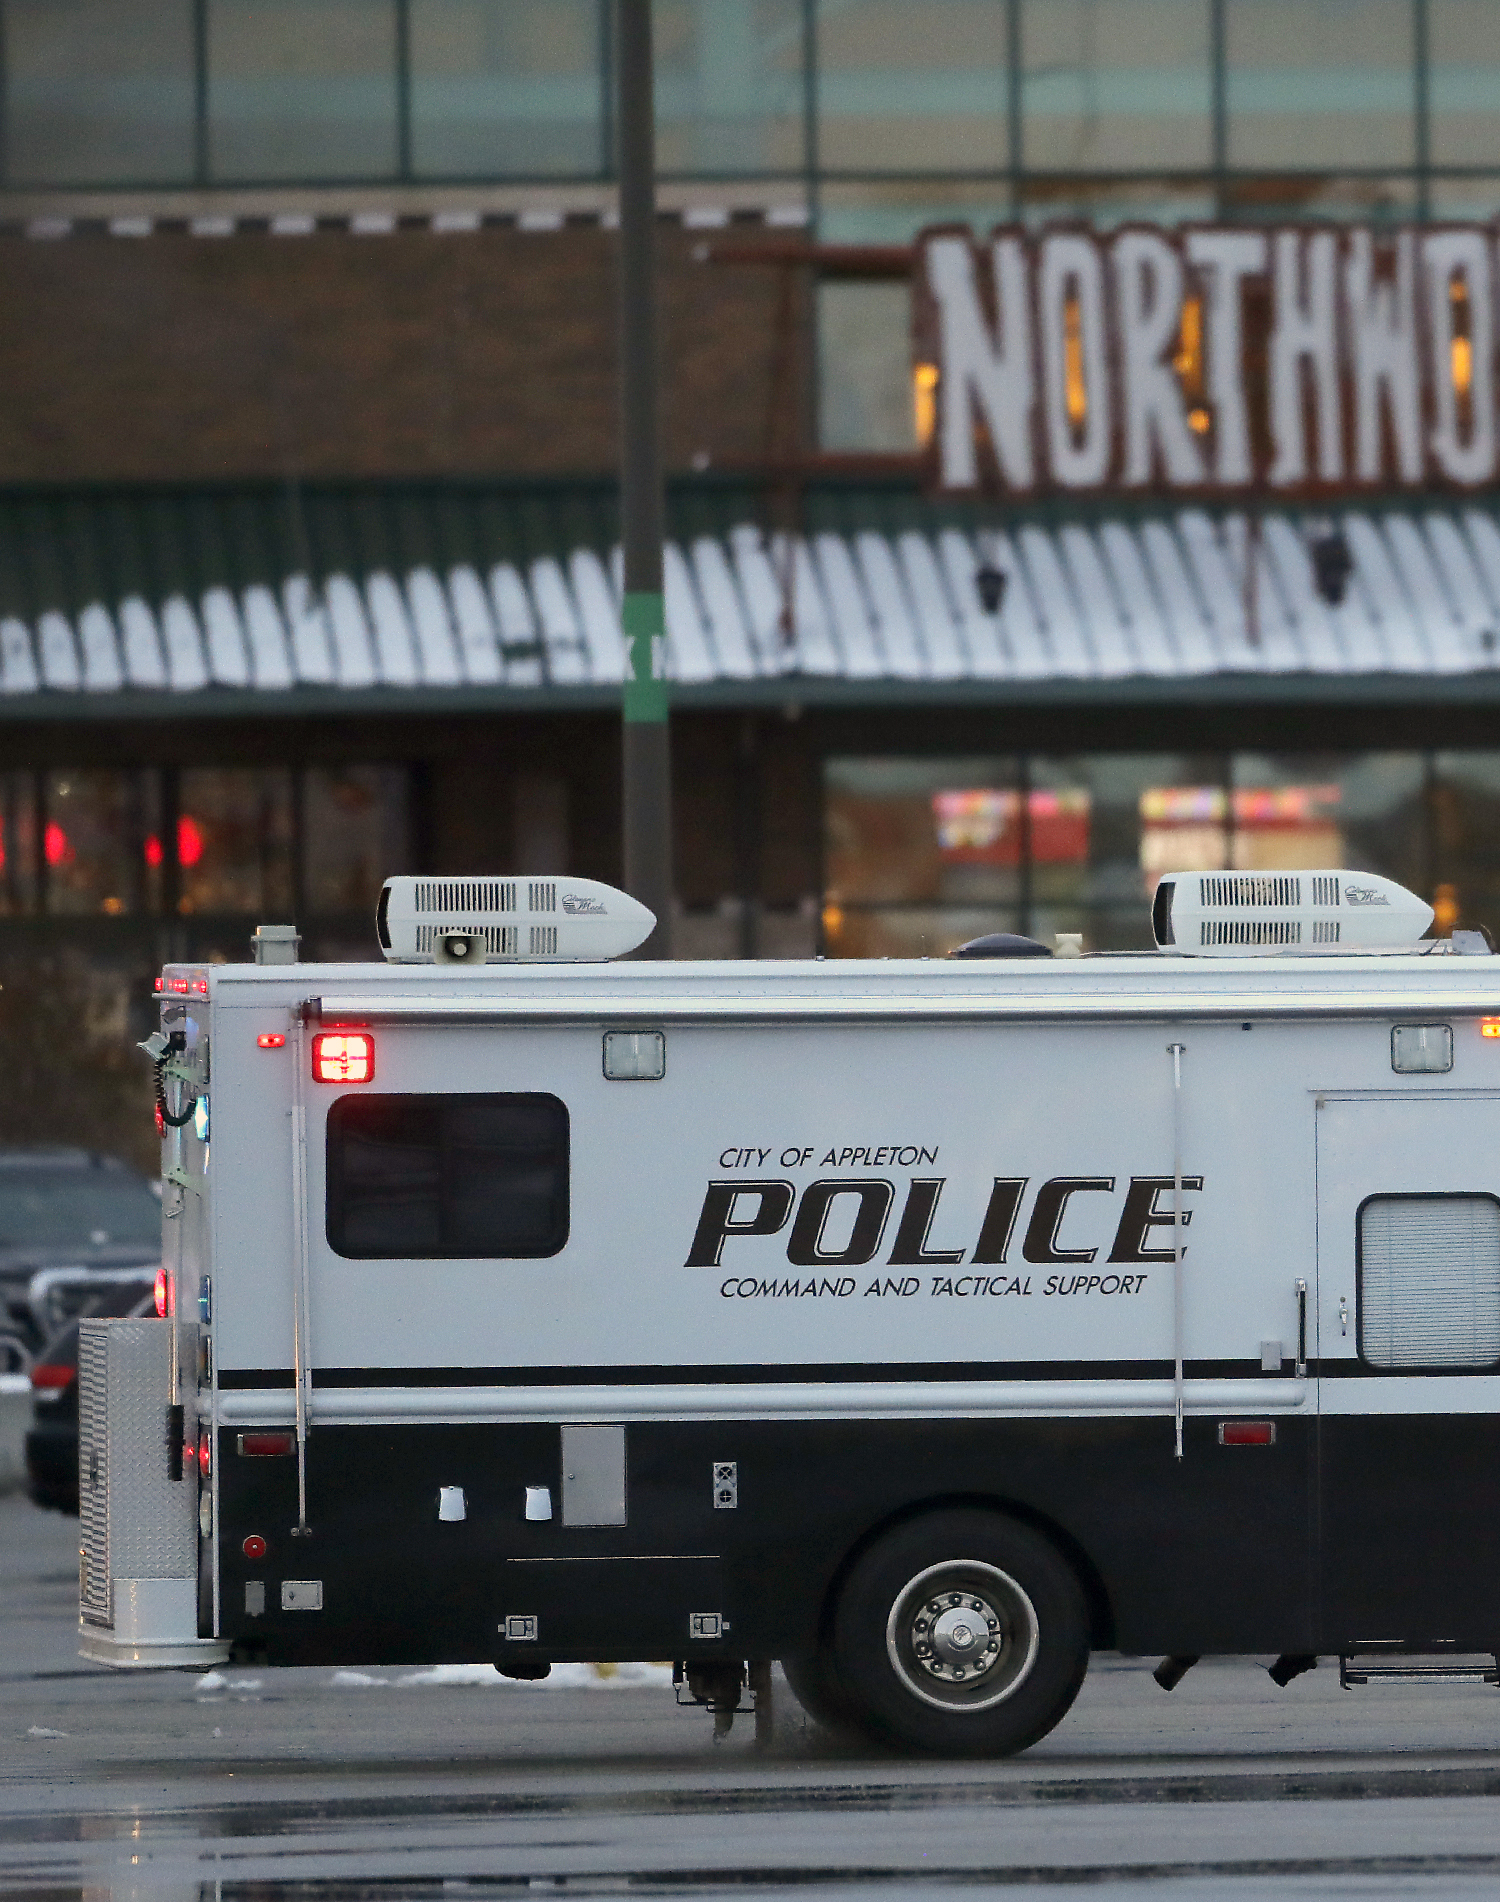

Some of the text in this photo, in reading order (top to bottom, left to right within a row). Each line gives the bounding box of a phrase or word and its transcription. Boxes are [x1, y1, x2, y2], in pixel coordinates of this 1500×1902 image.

[719, 1145, 939, 1169] CITY OF APPLETON
[683, 1176, 1204, 1268] POLICE
[720, 1274, 1148, 1299] COMMAND AND TACTICAL SUPPORT
